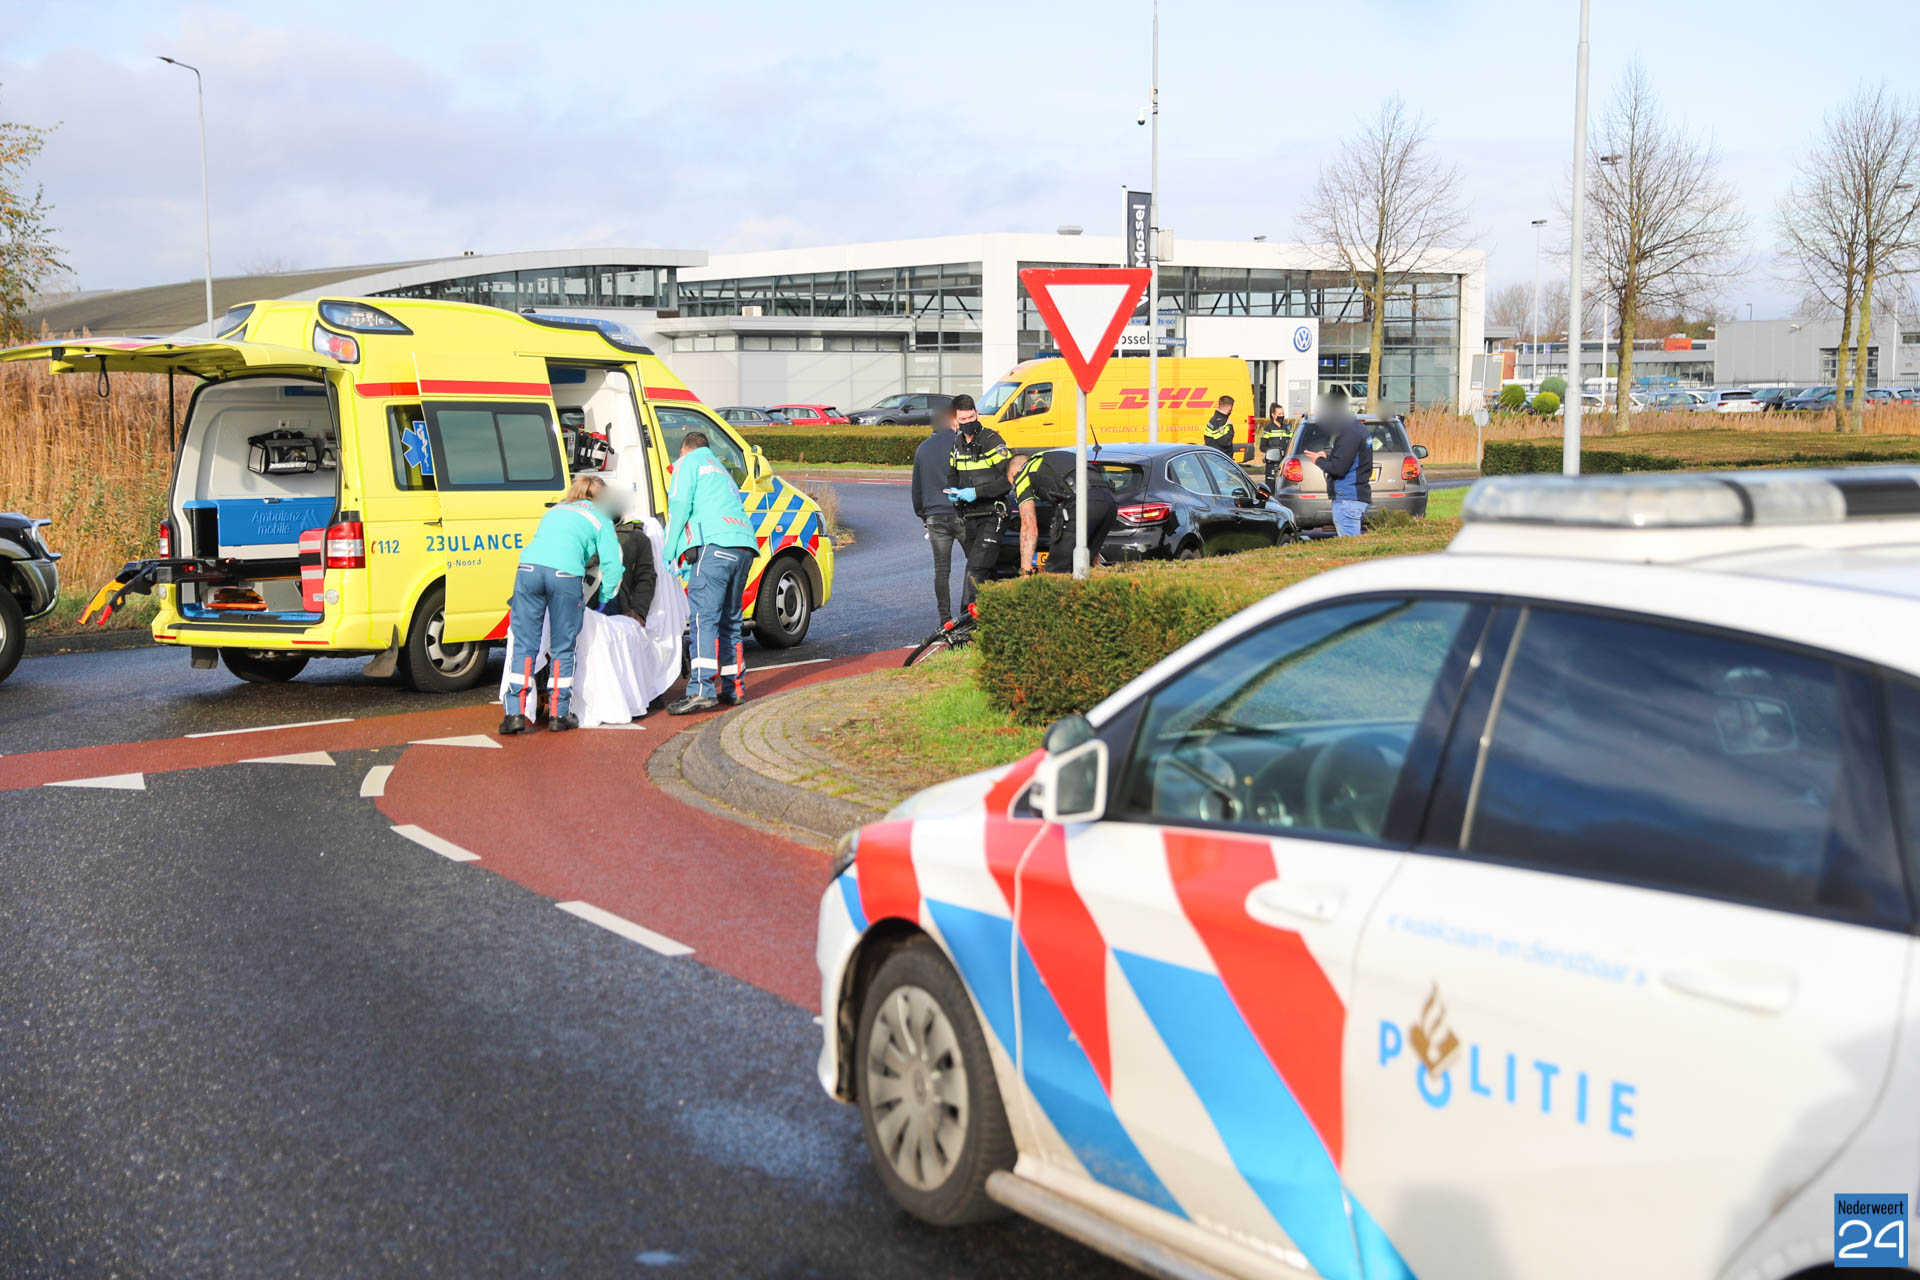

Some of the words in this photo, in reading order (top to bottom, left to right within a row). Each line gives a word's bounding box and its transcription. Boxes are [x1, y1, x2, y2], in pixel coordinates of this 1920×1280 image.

[1133, 204, 1147, 268] Mossel
[1116, 330, 1150, 345] ossel
[1118, 387, 1214, 410] DHL
[257, 522, 291, 536] mobile
[1378, 1018, 1638, 1140] POLITIE
